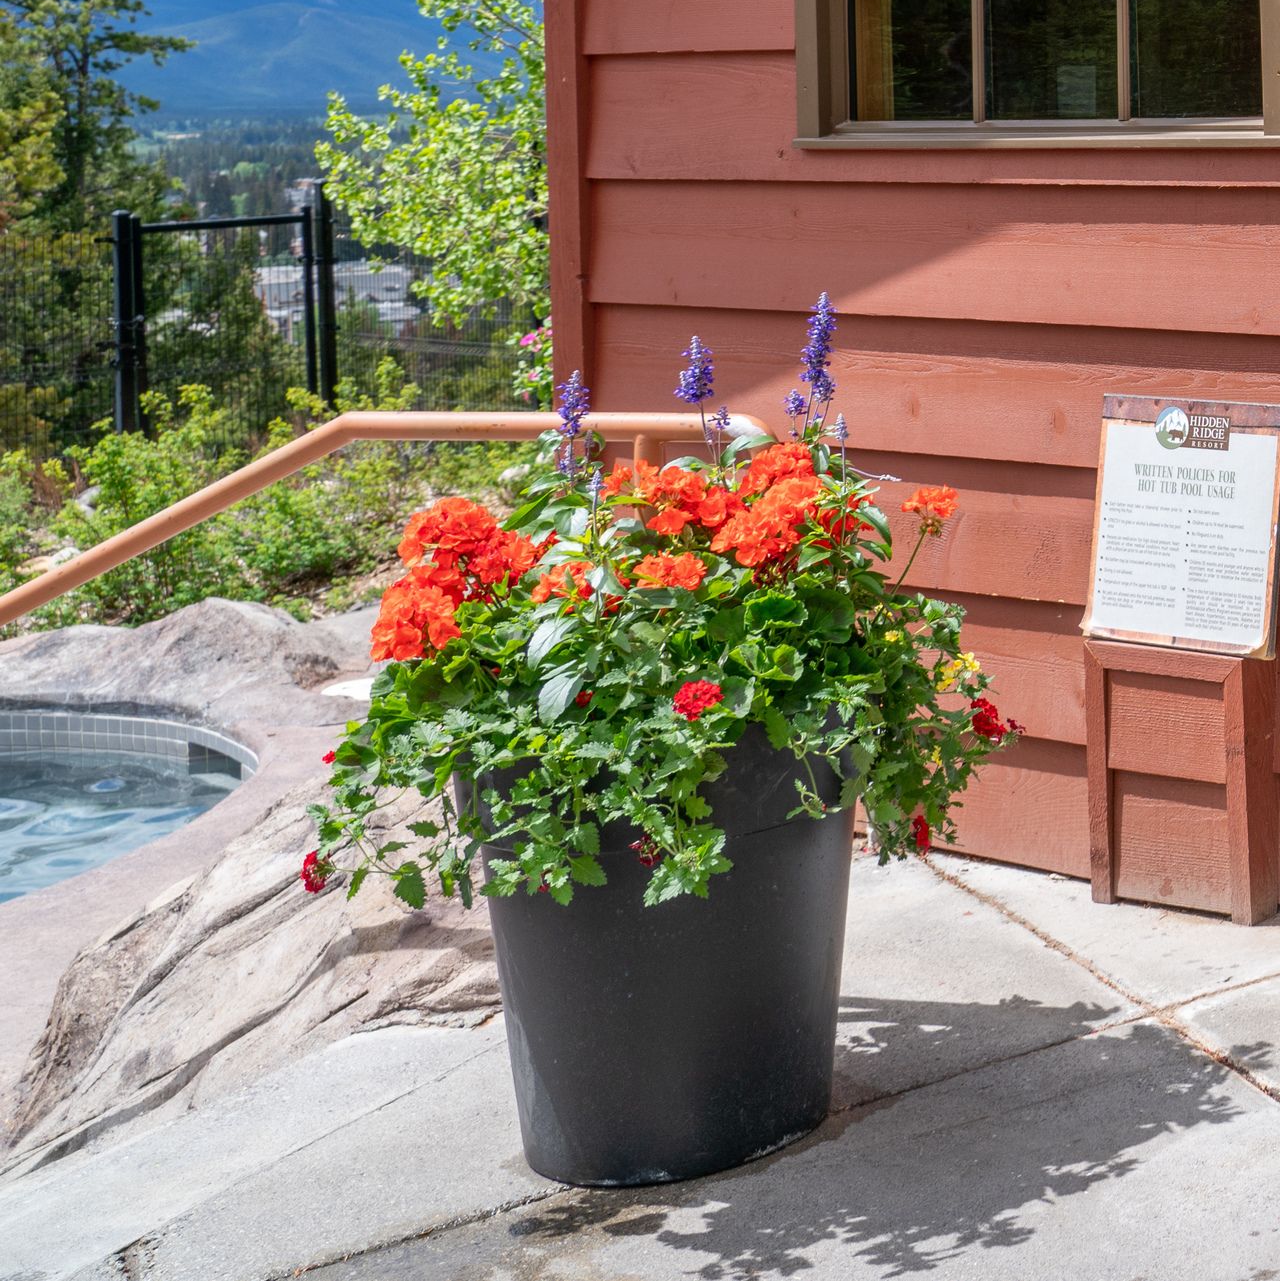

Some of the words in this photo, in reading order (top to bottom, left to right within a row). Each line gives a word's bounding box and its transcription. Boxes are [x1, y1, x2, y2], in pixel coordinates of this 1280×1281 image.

[1190, 416, 1229, 428] HIDDEN
[1193, 428, 1224, 439] RIDGE
[1134, 464, 1173, 478] WRITTEN
[1177, 467, 1214, 482] POLICIES
[1219, 470, 1236, 484] FOR
[1138, 479, 1156, 492] HOT
[1160, 481, 1176, 494] TUB
[1181, 483, 1203, 496] POOL
[1208, 486, 1235, 499] USAGE
